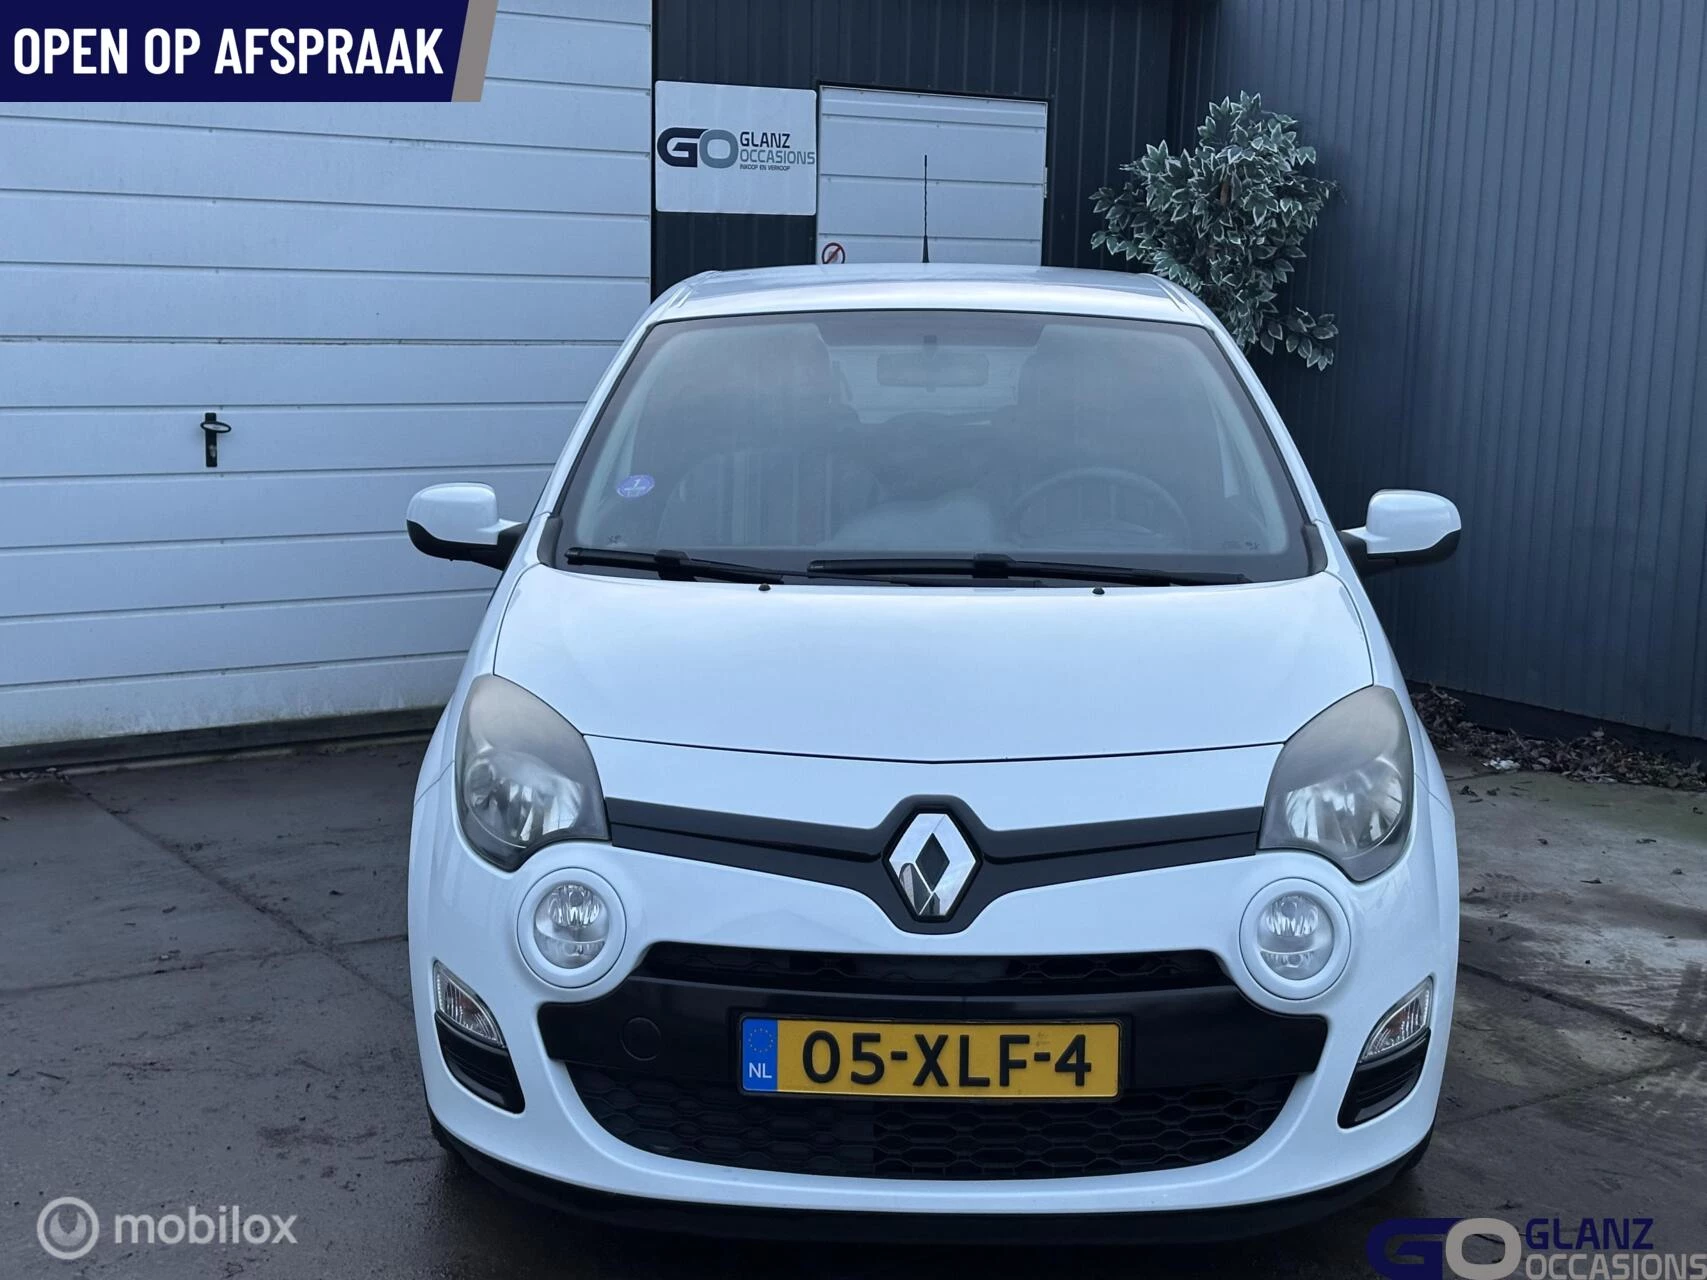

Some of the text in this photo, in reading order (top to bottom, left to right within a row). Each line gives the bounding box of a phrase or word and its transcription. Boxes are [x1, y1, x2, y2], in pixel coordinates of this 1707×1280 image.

[656, 127, 739, 169] GO
[740, 131, 791, 148] GLANZ
[740, 149, 815, 165] OCCASIONS
[802, 1030, 1092, 1087] 05-XLF-4
[748, 1062, 772, 1079] NL
